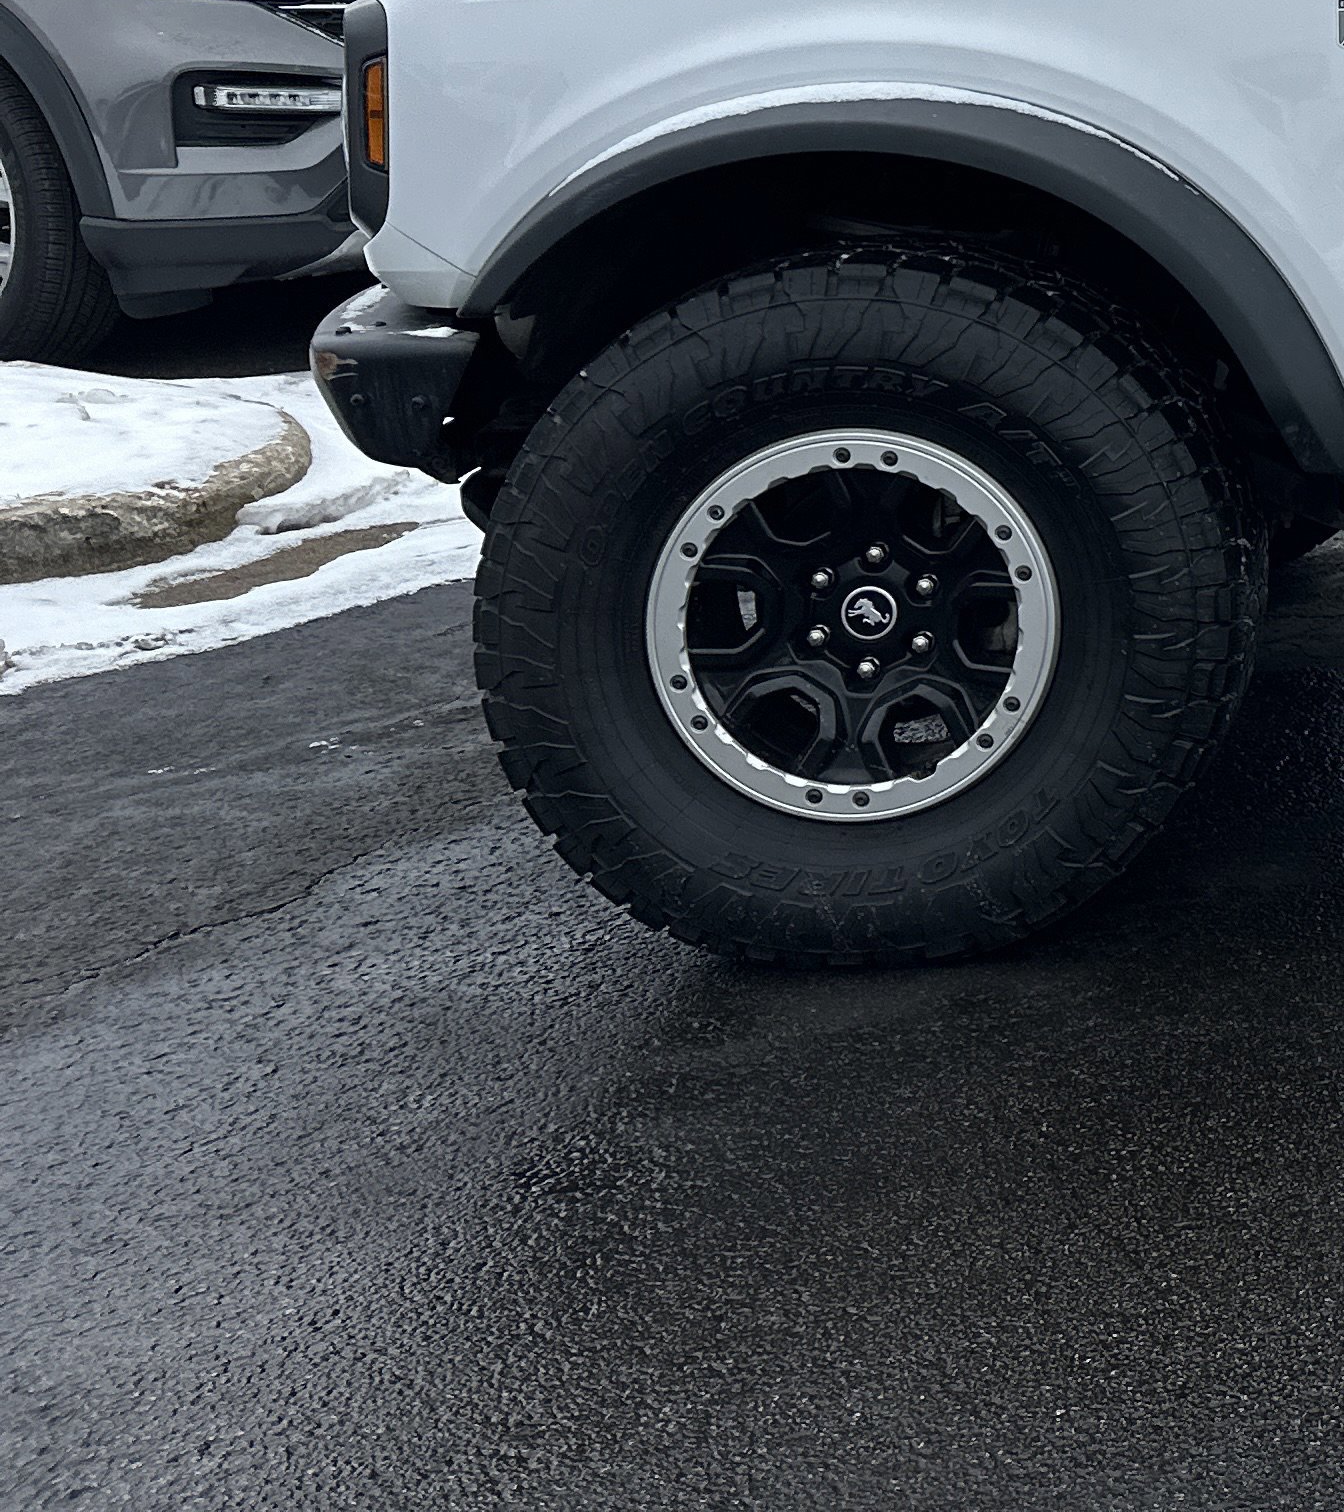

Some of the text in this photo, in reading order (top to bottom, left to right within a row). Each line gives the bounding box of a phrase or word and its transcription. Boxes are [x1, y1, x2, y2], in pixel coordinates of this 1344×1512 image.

[580, 428, 670, 568] OPEN
[683, 365, 950, 435] COUNTRY
[918, 787, 1060, 886] TOYO
